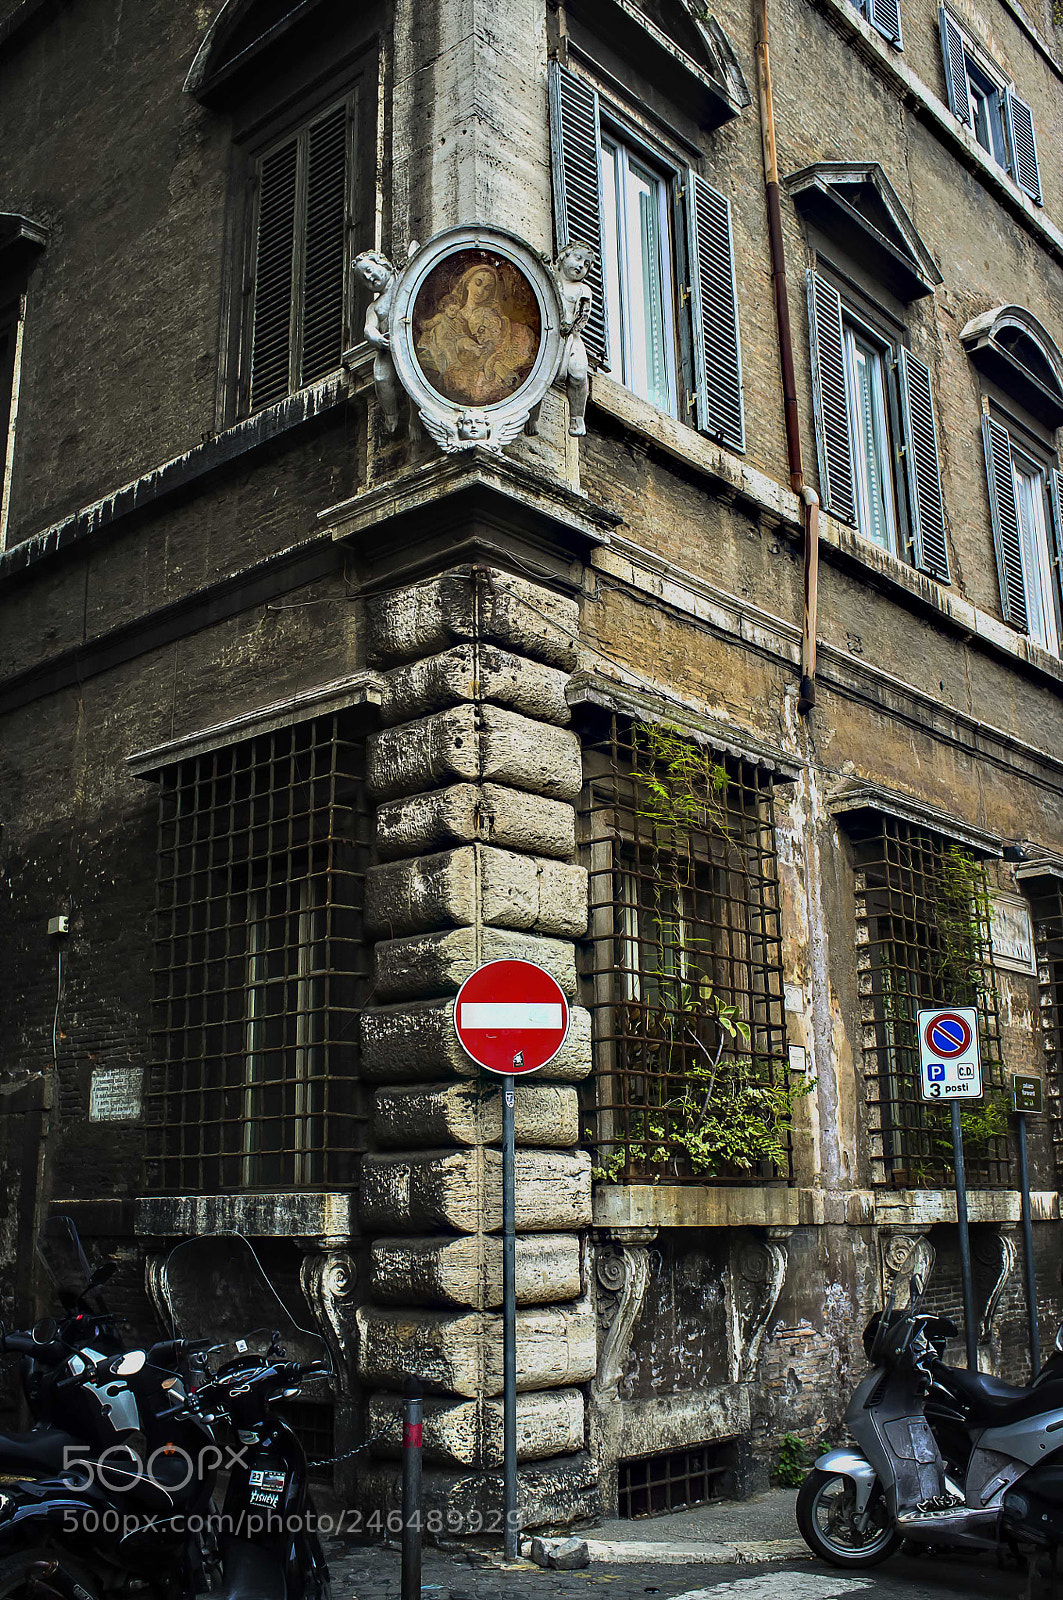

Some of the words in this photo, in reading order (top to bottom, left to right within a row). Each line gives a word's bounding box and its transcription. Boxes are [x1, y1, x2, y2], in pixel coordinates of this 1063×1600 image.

[931, 1066, 942, 1080] P
[959, 1066, 974, 1076] C.D.
[929, 1083, 941, 1098] 3
[945, 1083, 969, 1093] posti
